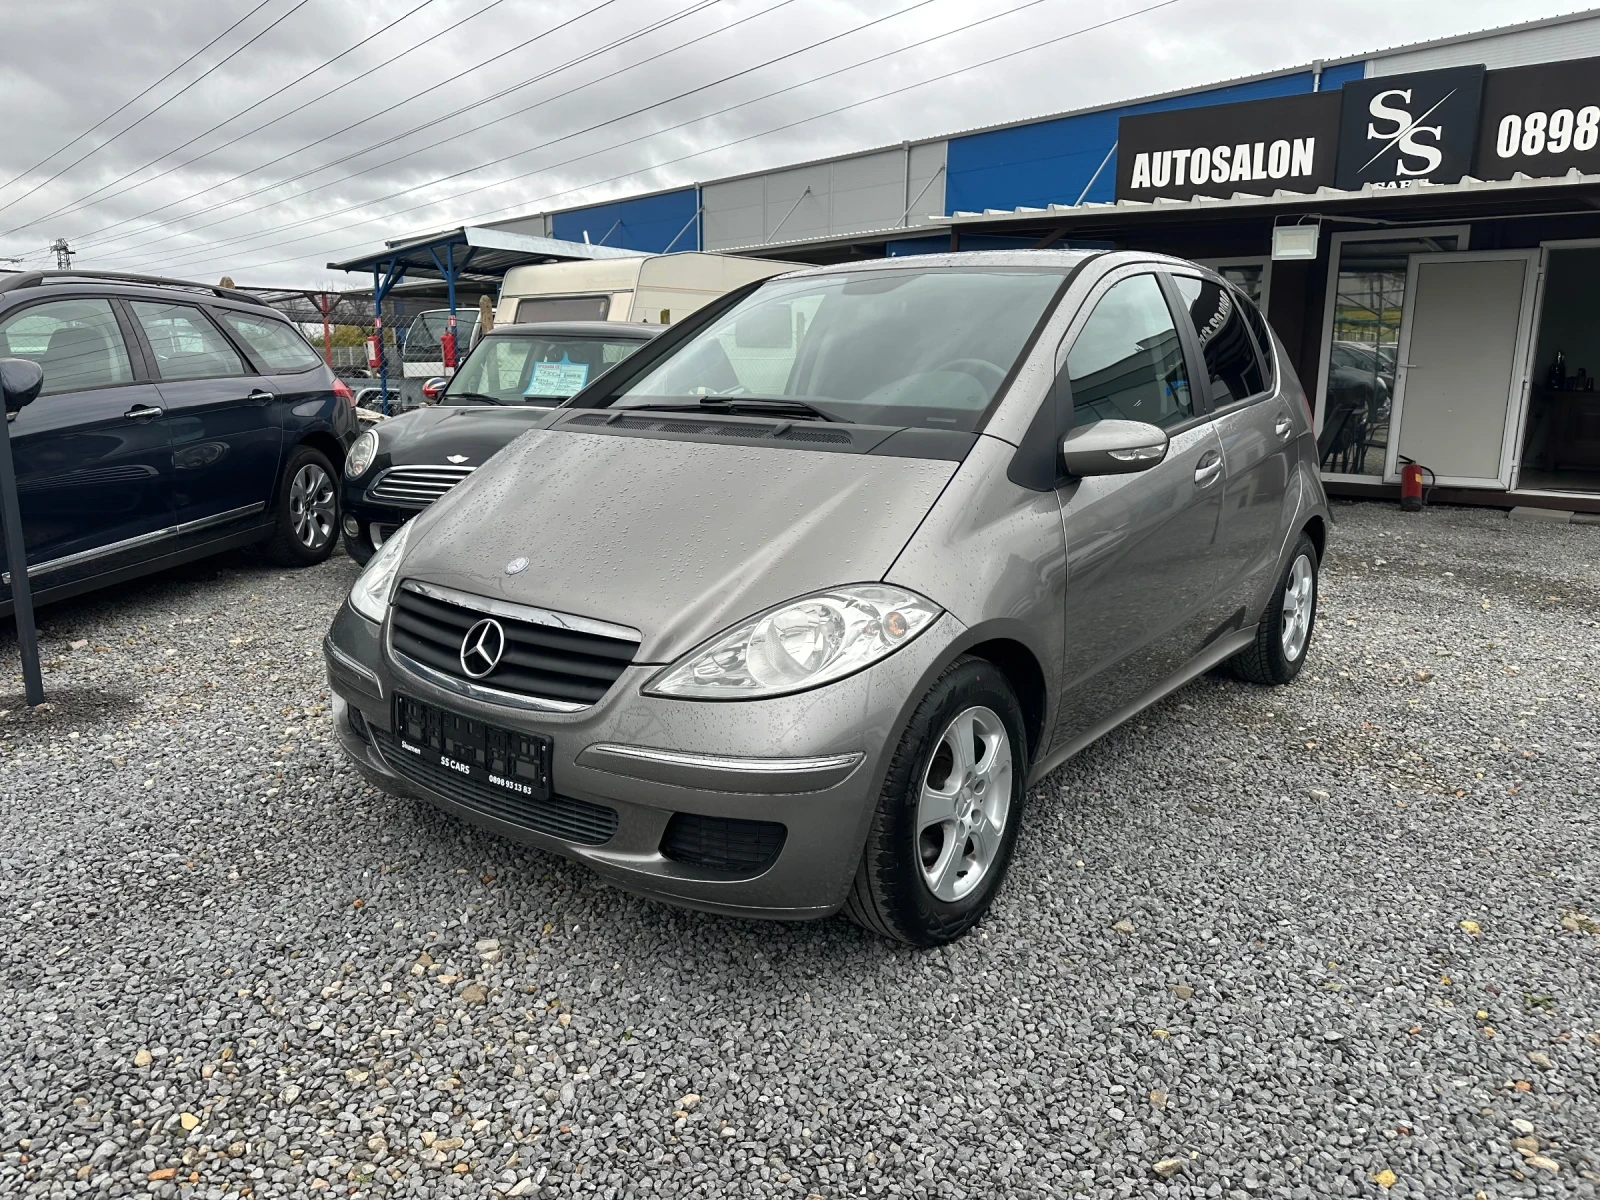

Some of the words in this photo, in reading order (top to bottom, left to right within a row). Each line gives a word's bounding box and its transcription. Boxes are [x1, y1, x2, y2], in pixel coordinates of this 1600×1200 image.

[1496, 105, 1600, 159] 0898
[1130, 137, 1315, 189] AUTOSALON
[1370, 178, 1429, 190] AR
[440, 756, 450, 767] SS
[450, 759, 470, 775] CARS
[488, 774, 505, 787] 0898
[505, 780, 514, 789] 93
[514, 782, 523, 792] 13
[523, 785, 532, 795] 83
